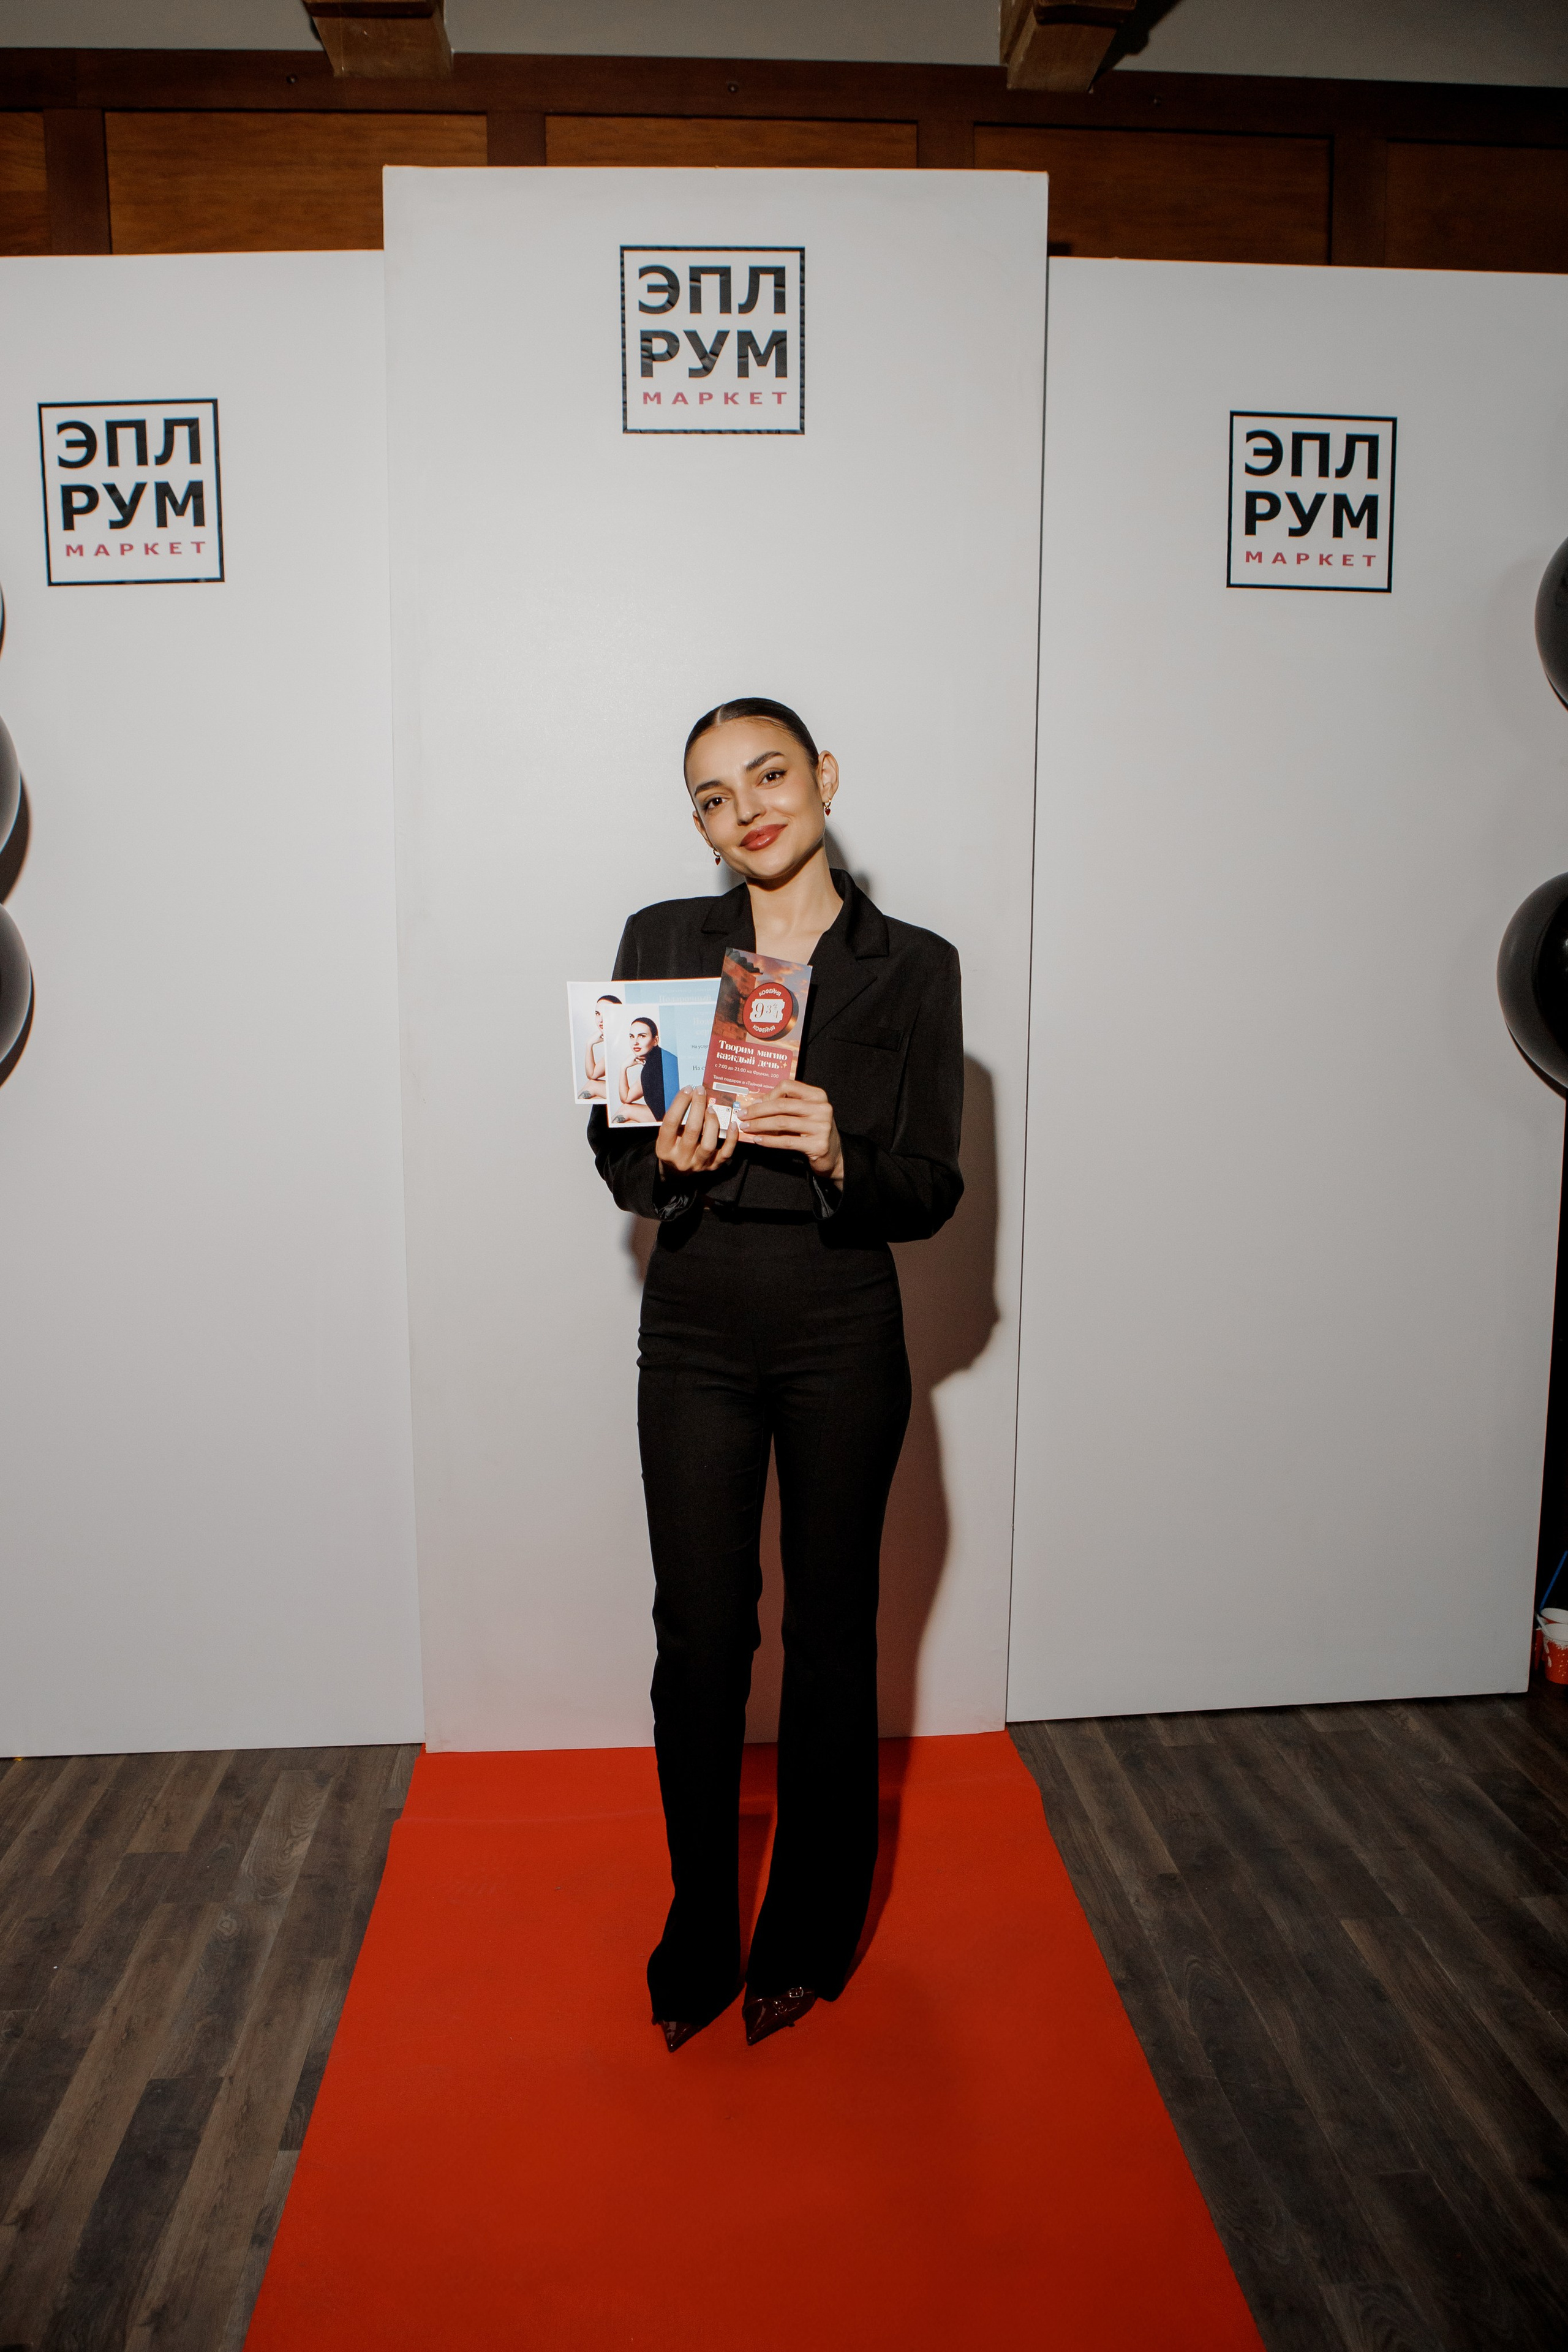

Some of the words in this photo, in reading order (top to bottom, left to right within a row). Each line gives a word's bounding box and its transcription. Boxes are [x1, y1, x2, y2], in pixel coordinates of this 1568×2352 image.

[638, 265, 786, 315] ЭПЛ
[639, 330, 788, 379] РУМ
[643, 391, 788, 405] МАРКЕТ
[56, 417, 203, 470] ЭПЛ
[1244, 429, 1380, 481] ЭПЛ
[60, 480, 206, 532] РУМ
[1244, 490, 1379, 541] РУМ
[65, 541, 206, 557] МАРКЕТ
[1245, 550, 1377, 568] МАРКЕТ
[758, 988, 782, 997] КОФЕЙНЯ
[754, 1002, 764, 1018] 9
[752, 1025, 775, 1033] КОФЕЙНЯ
[718, 1040, 754, 1055] Творим
[756, 1050, 788, 1061] магию
[716, 1052, 755, 1065] каждый
[758, 1060, 780, 1069] день
